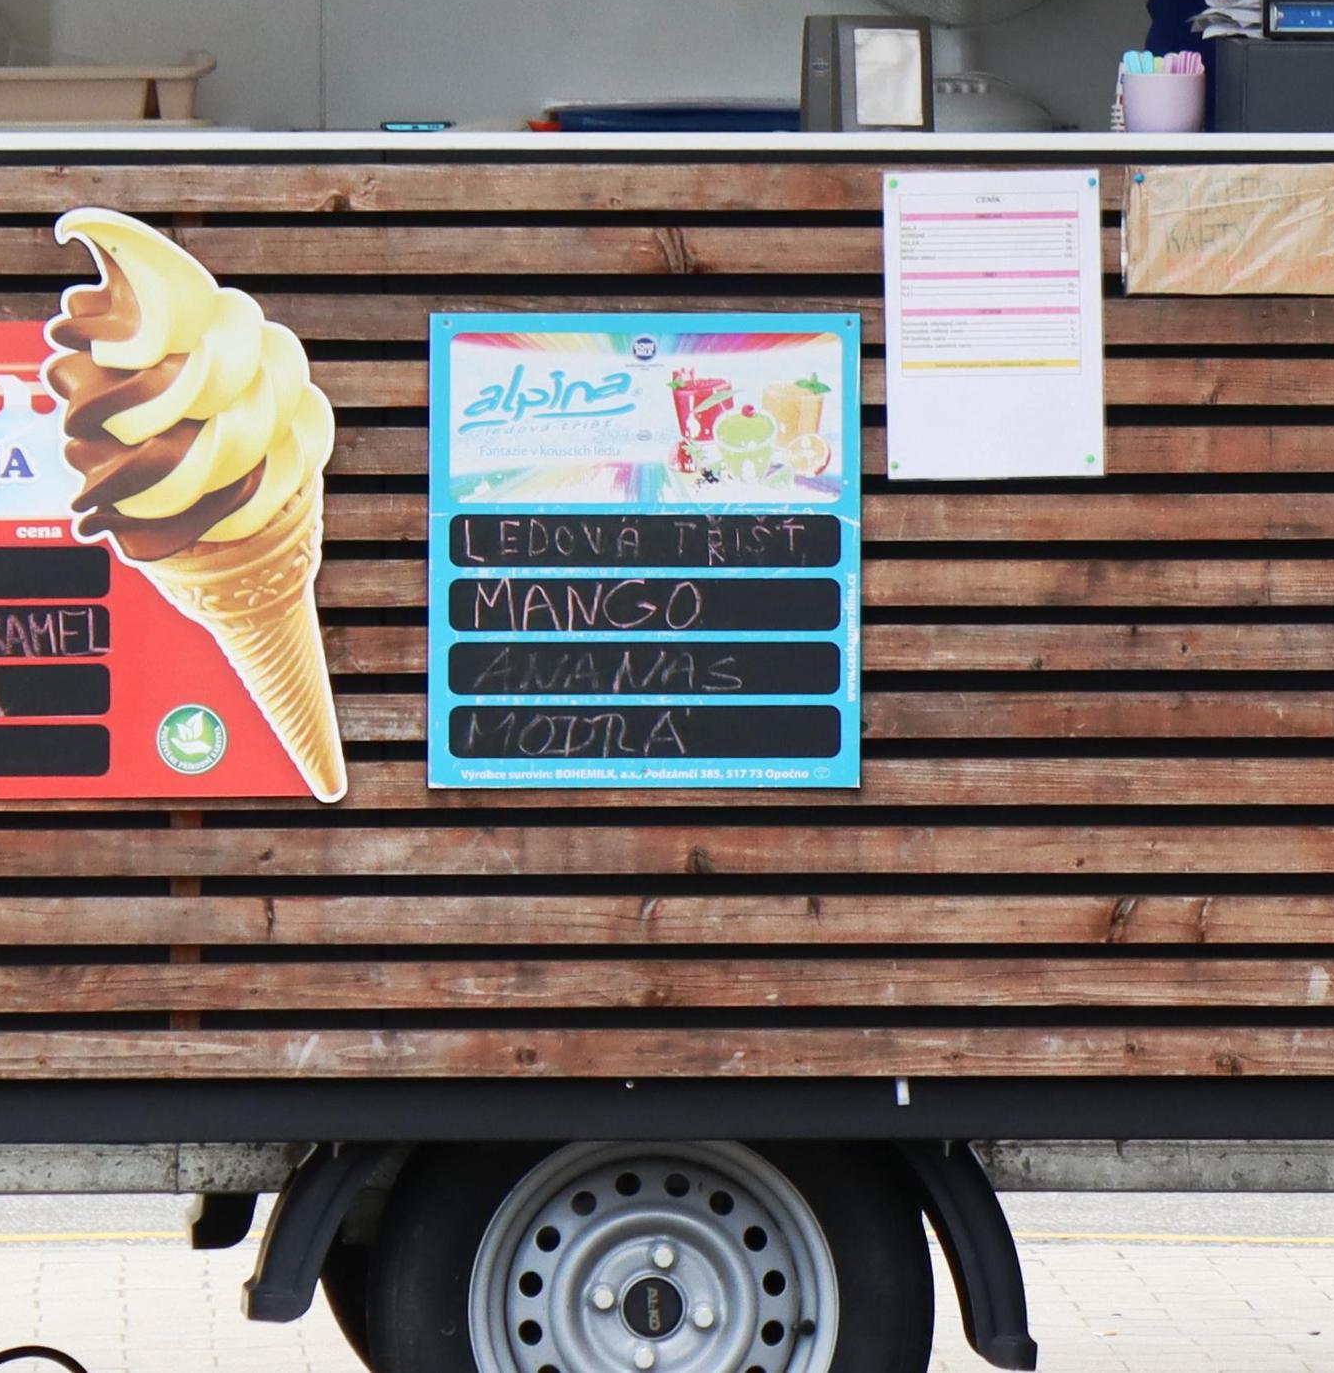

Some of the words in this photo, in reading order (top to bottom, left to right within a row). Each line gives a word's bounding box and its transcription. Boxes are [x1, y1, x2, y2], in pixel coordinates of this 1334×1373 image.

[463, 364, 632, 421] alpina
[16, 527, 63, 539] cena
[473, 577, 702, 631] MANGO
[461, 768, 506, 781] Výrobce
[508, 768, 553, 780] surovin:
[765, 768, 809, 782] Opočno
